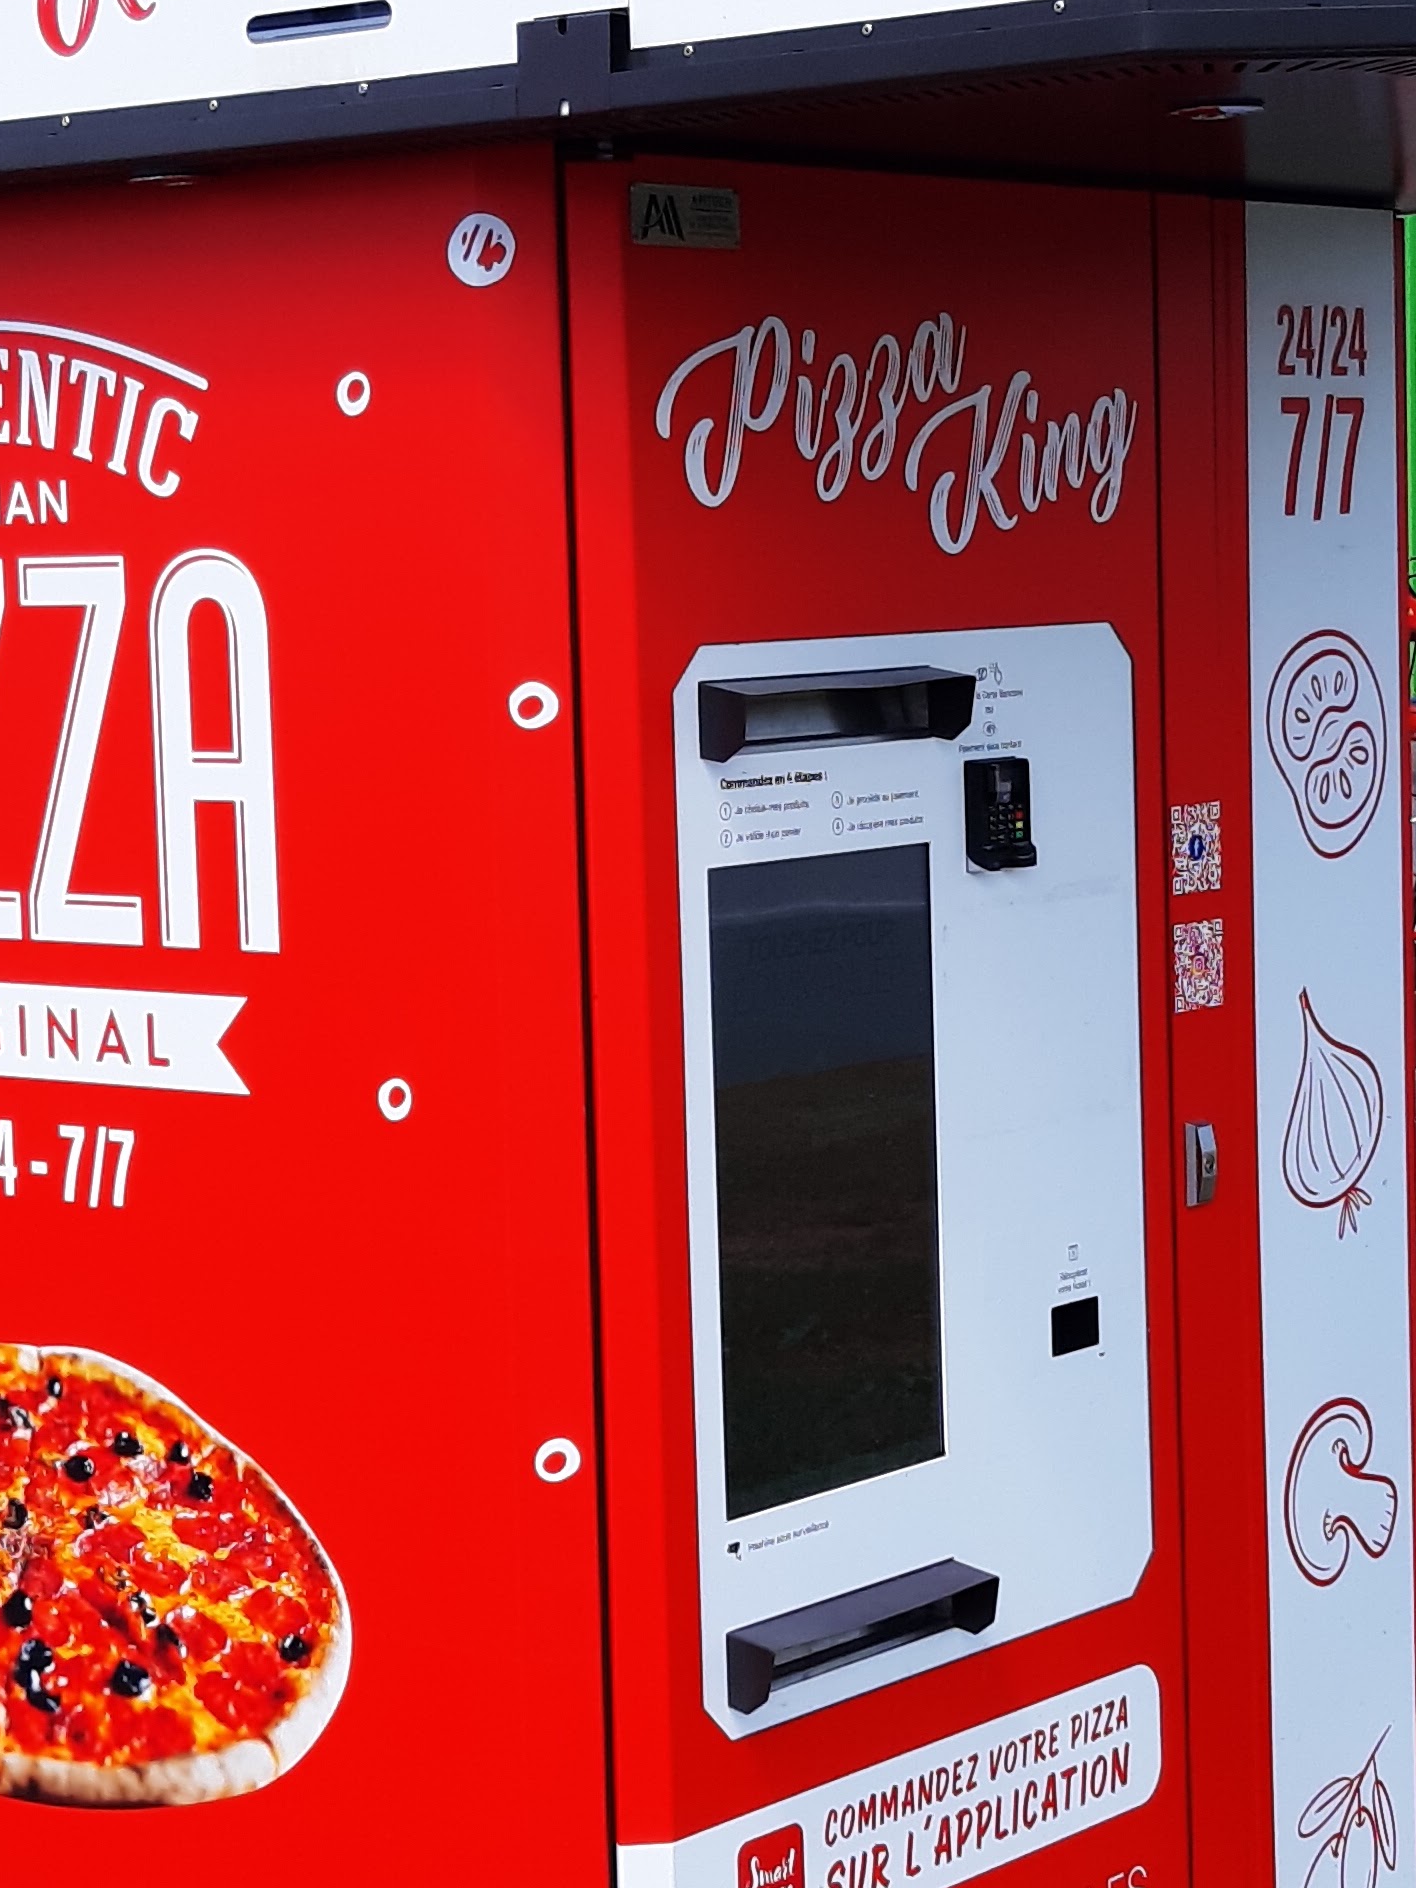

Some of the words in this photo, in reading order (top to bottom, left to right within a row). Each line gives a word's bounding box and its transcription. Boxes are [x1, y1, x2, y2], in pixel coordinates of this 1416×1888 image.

[655, 312, 967, 508] Pizza
[1276, 304, 1368, 380] 24/24
[904, 370, 1138, 555] King
[1281, 396, 1366, 522] 7/7
[58, 1124, 135, 1208] 7/7
[824, 1752, 979, 1848] COMMANDEZ
[989, 1720, 1061, 1781] VOTRE
[1070, 1694, 1129, 1750] PIZZA
